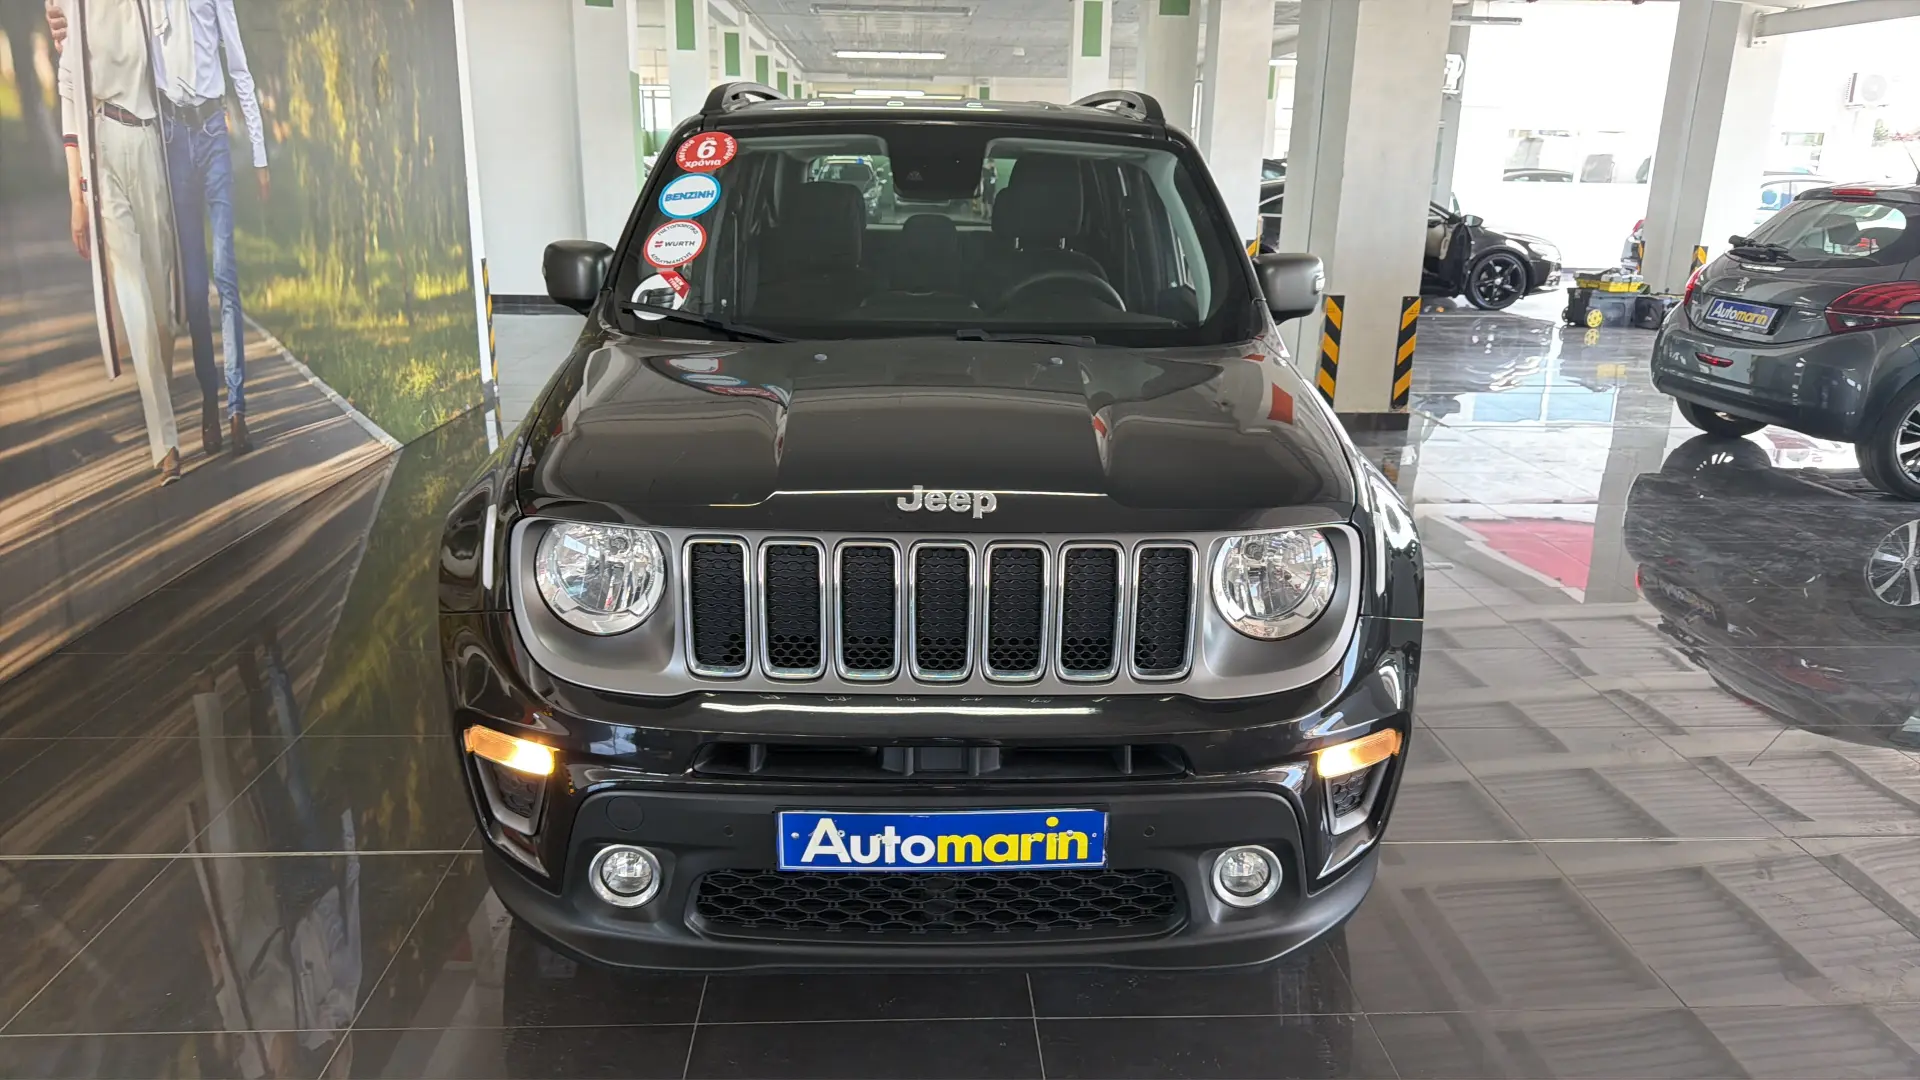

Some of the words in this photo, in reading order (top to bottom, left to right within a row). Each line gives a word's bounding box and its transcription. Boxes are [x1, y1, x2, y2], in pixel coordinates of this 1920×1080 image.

[697, 140, 717, 159] 6
[684, 159, 721, 168] χρόνια
[665, 190, 714, 202] ΒΕΝΖΙΝΗ
[1711, 302, 1769, 325] Automarin
[896, 484, 998, 519] Jeep
[801, 816, 1088, 864] Automarin
